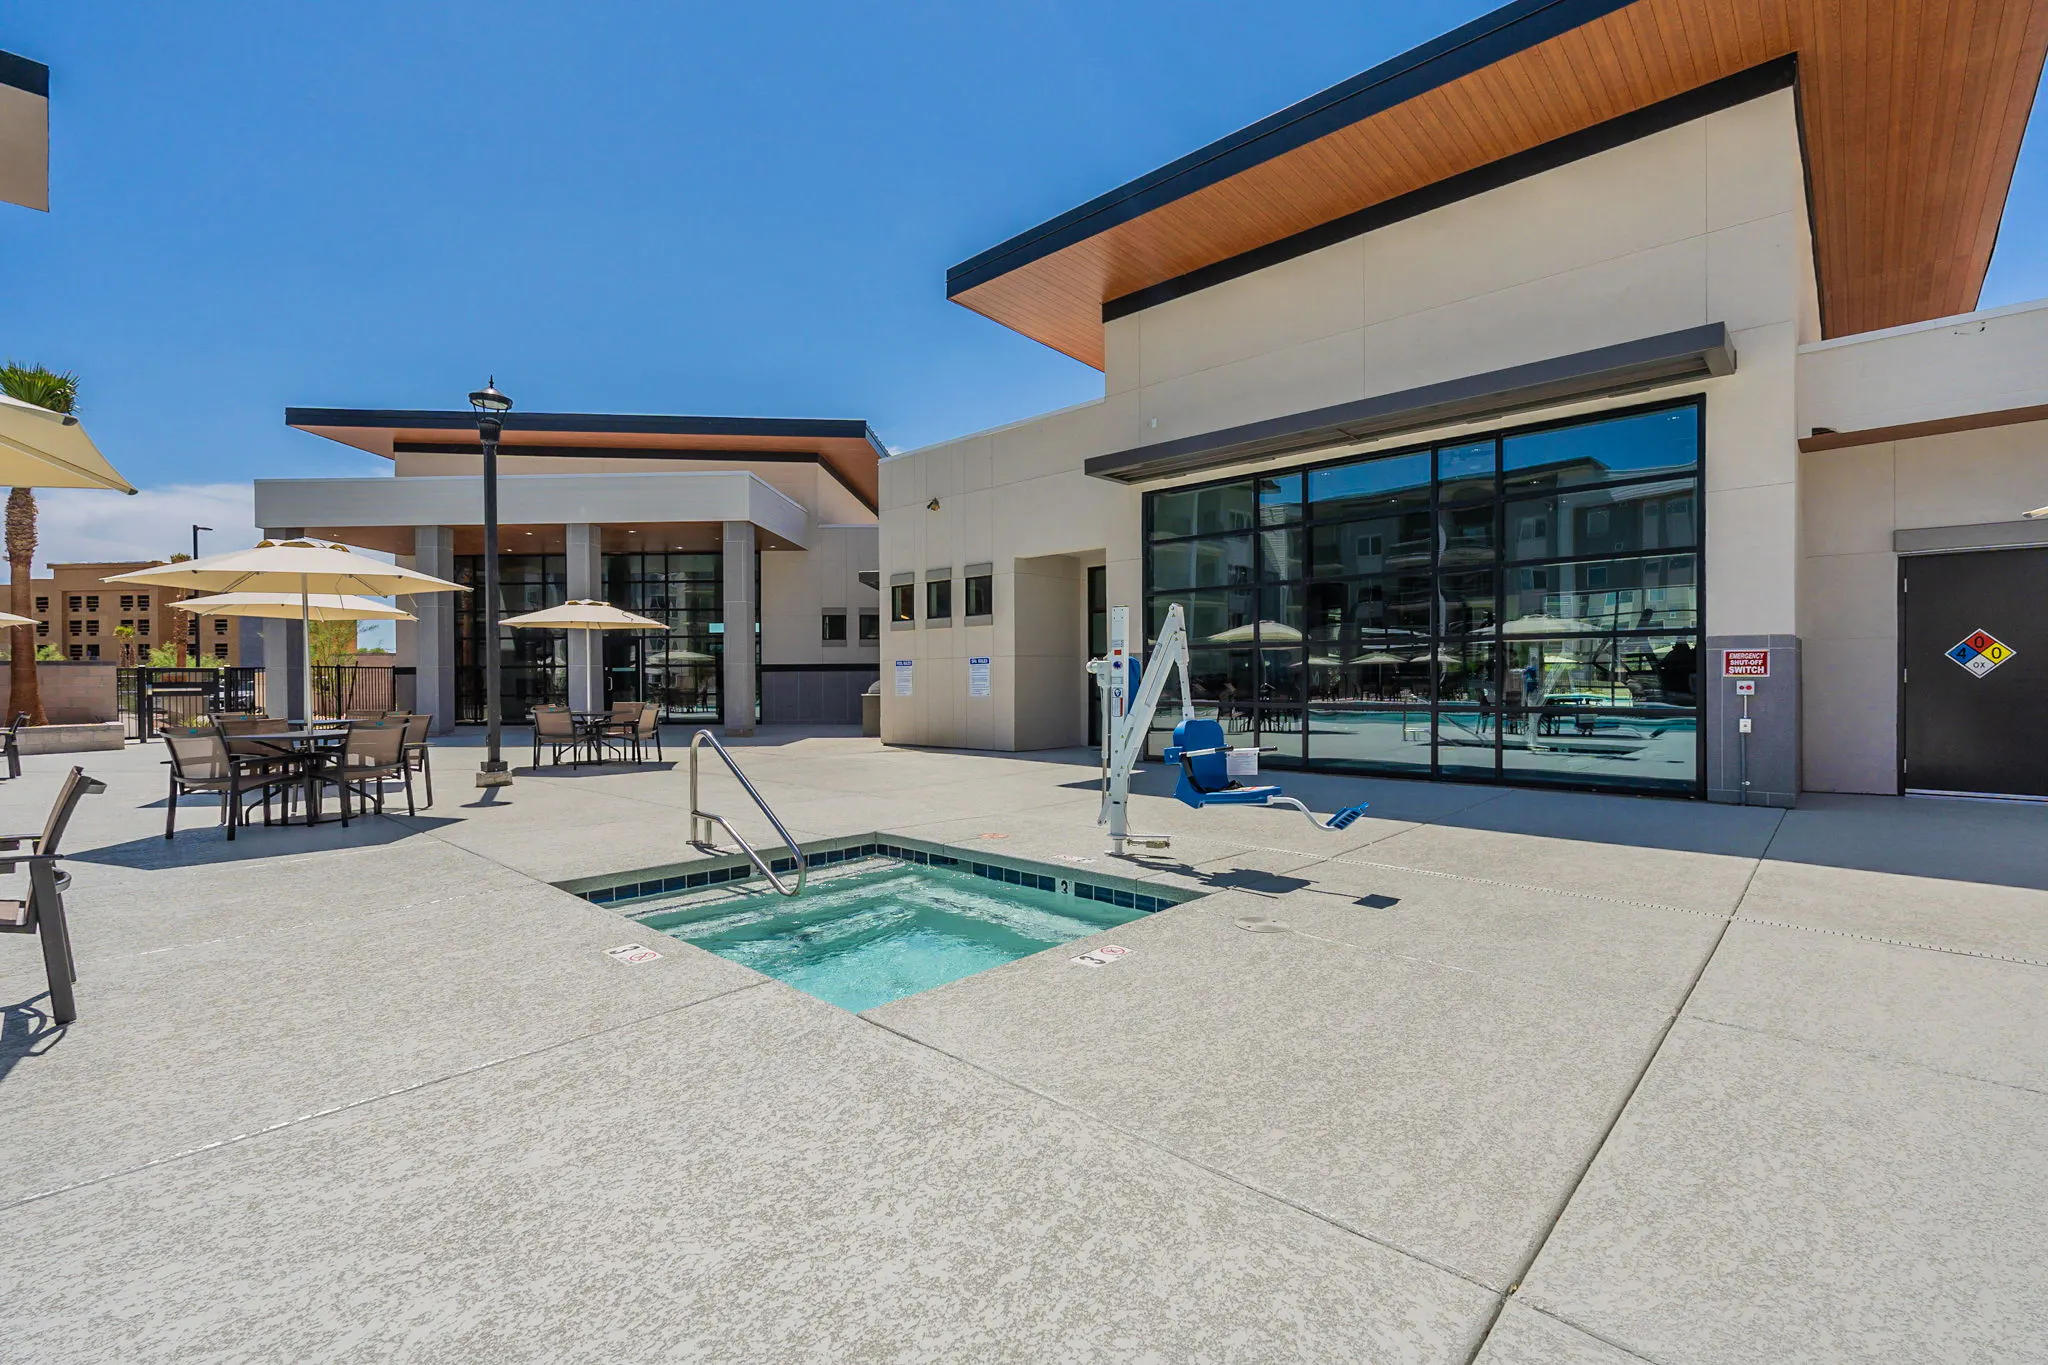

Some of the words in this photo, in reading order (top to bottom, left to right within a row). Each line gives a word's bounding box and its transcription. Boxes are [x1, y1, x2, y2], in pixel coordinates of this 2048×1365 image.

[1974, 636, 1984, 648] 0
[1956, 647, 1966, 659] 4
[1991, 647, 2002, 659] 0
[1728, 666, 1764, 674] SWITCH
[1079, 955, 1106, 964] 3
